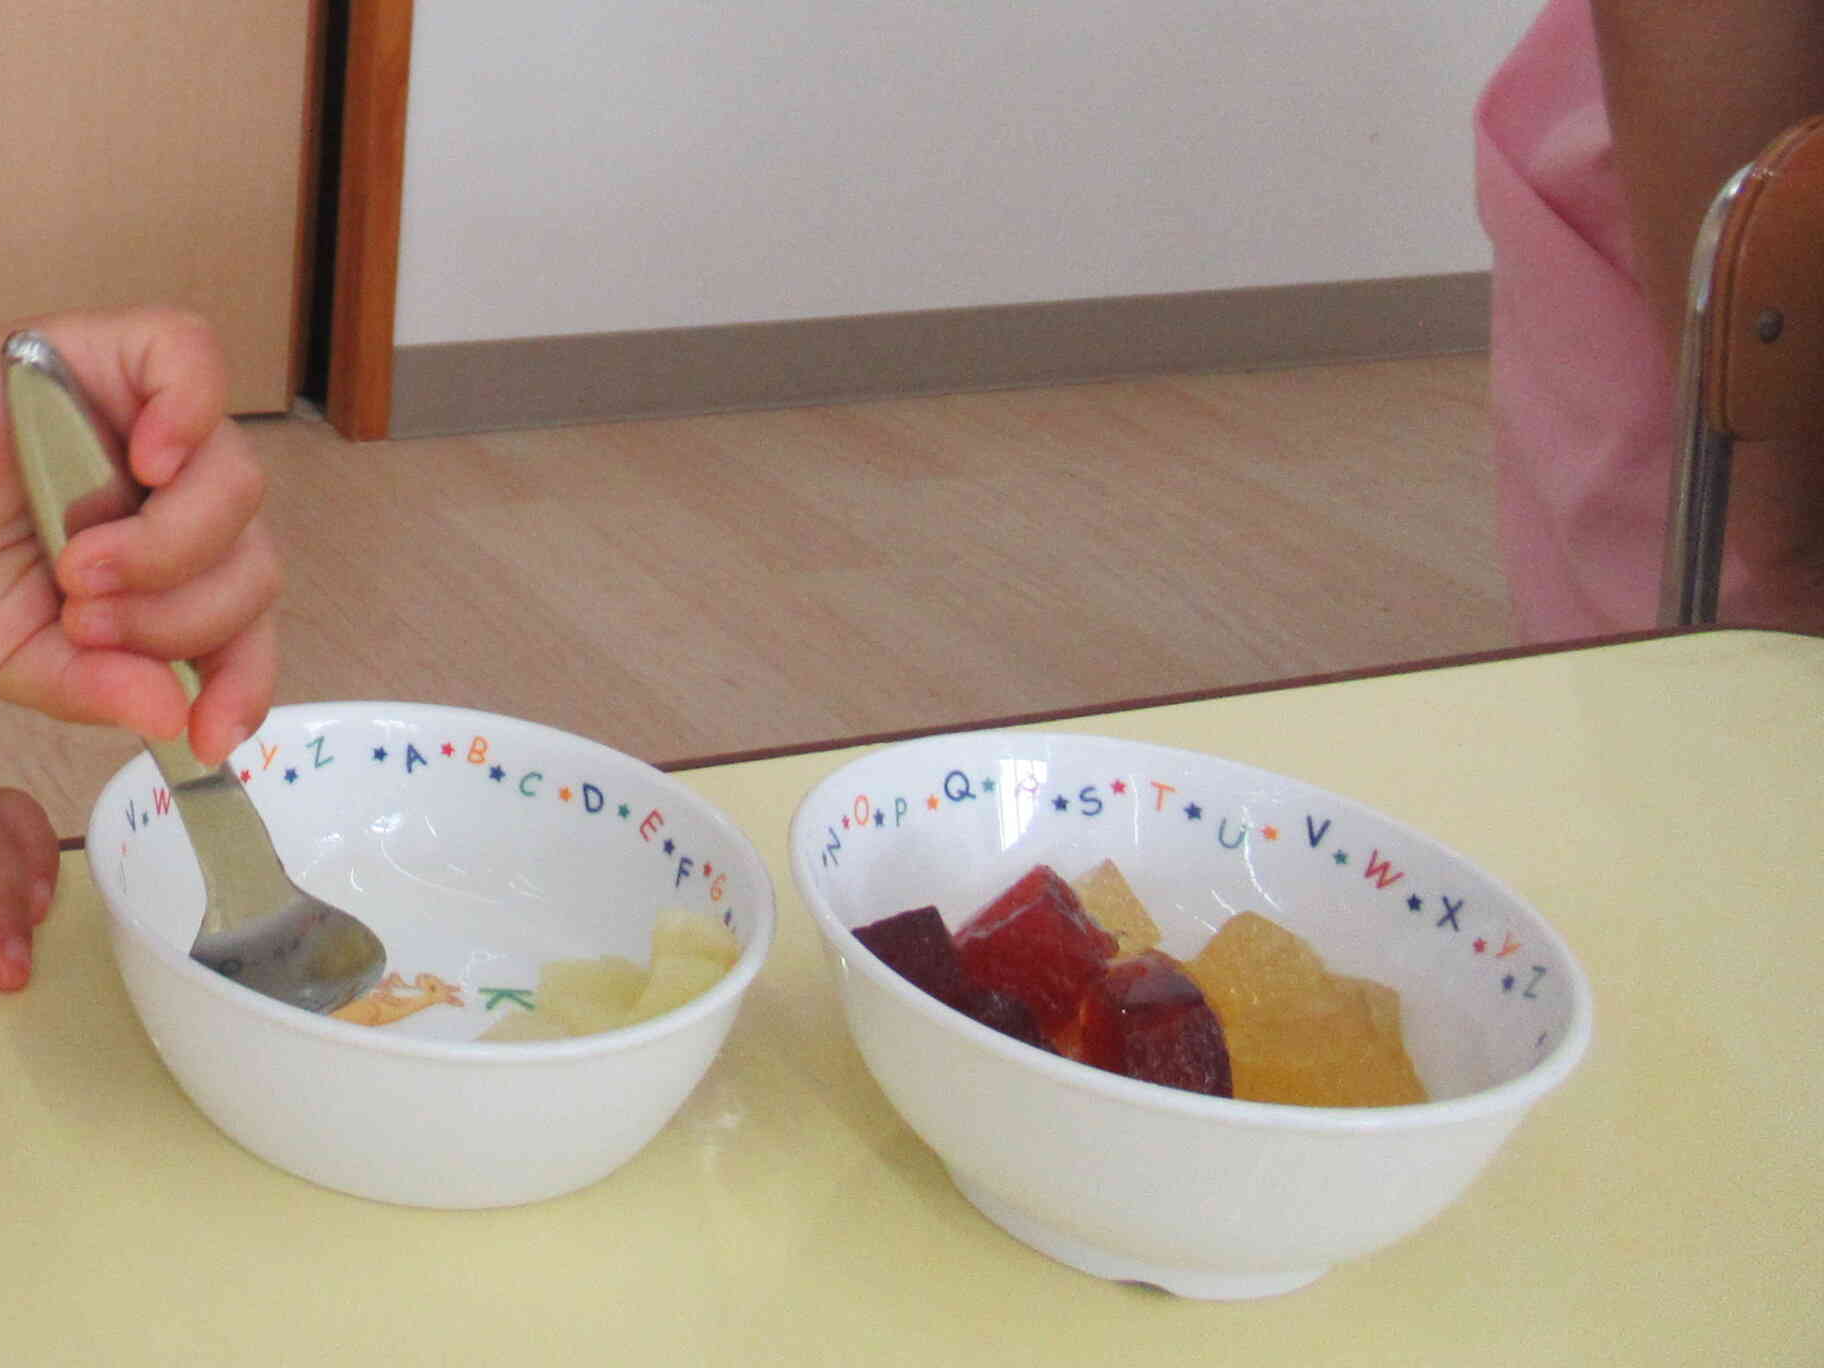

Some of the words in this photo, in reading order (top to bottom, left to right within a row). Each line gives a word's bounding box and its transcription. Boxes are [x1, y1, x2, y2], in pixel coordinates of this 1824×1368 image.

[153, 787, 172, 816] W
[258, 739, 278, 770] Y
[305, 736, 335, 769] Z
[405, 743, 428, 773] A
[467, 736, 489, 764] B
[518, 771, 543, 797] C
[582, 783, 604, 814] D
[639, 808, 664, 842] E
[675, 856, 694, 888] F
[709, 873, 727, 902] G
[853, 794, 870, 827] O
[894, 797, 908, 827] P
[944, 769, 977, 803] Q
[1079, 786, 1104, 817] S
[1150, 781, 1176, 812] T
[1218, 818, 1247, 850] U
[1307, 815, 1331, 849] V
[1364, 849, 1405, 889] W
[1436, 896, 1464, 932] X
[1495, 932, 1522, 959] Y
[1523, 965, 1547, 999] Z
[478, 987, 536, 1011] K
